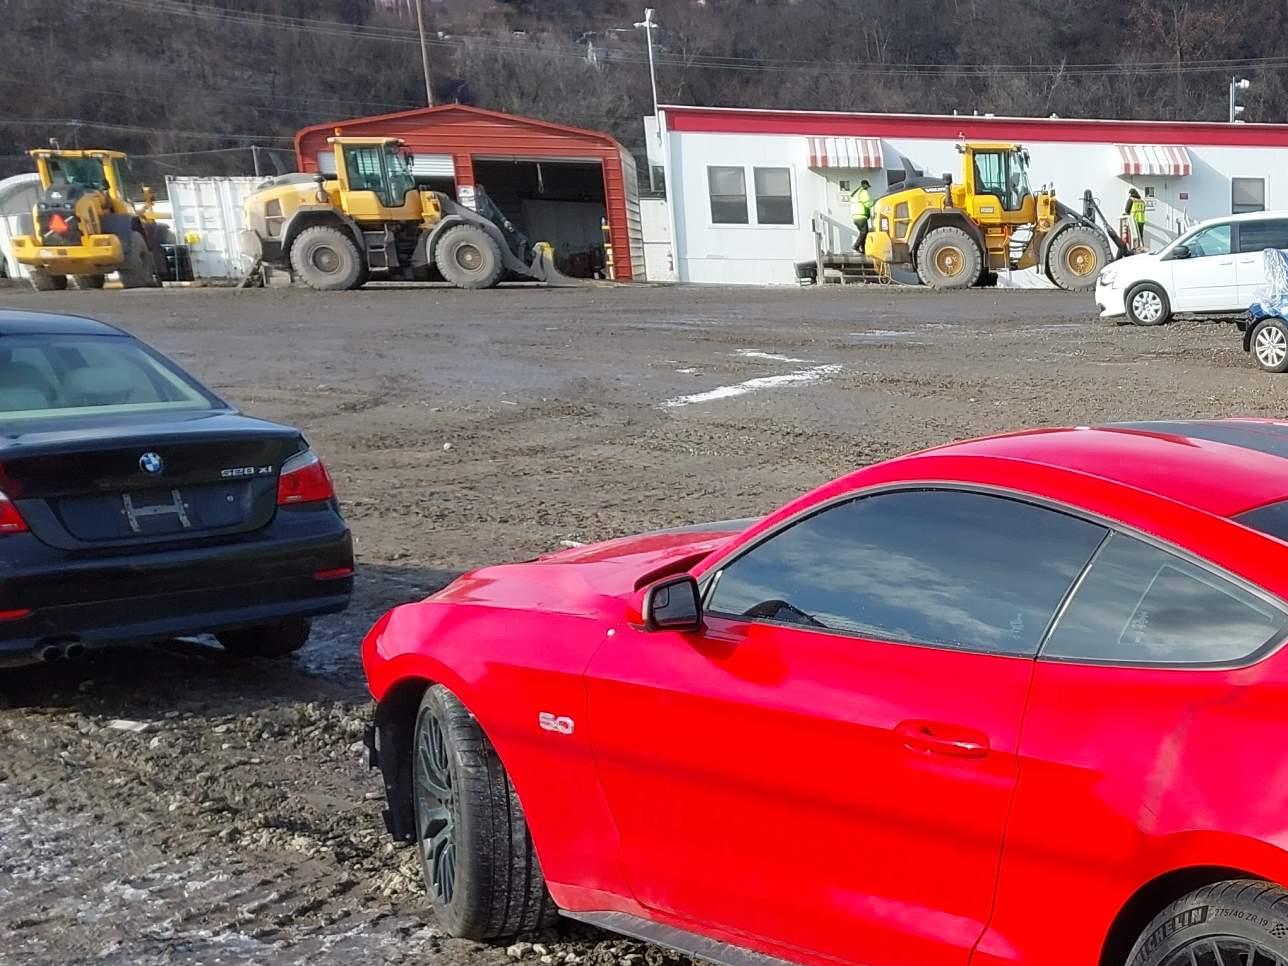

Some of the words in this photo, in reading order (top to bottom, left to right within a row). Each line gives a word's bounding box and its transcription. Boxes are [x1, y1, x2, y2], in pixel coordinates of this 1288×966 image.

[221, 467, 254, 477] 528
[1245, 912, 1258, 923] ZR
[1259, 917, 1268, 927] 19
